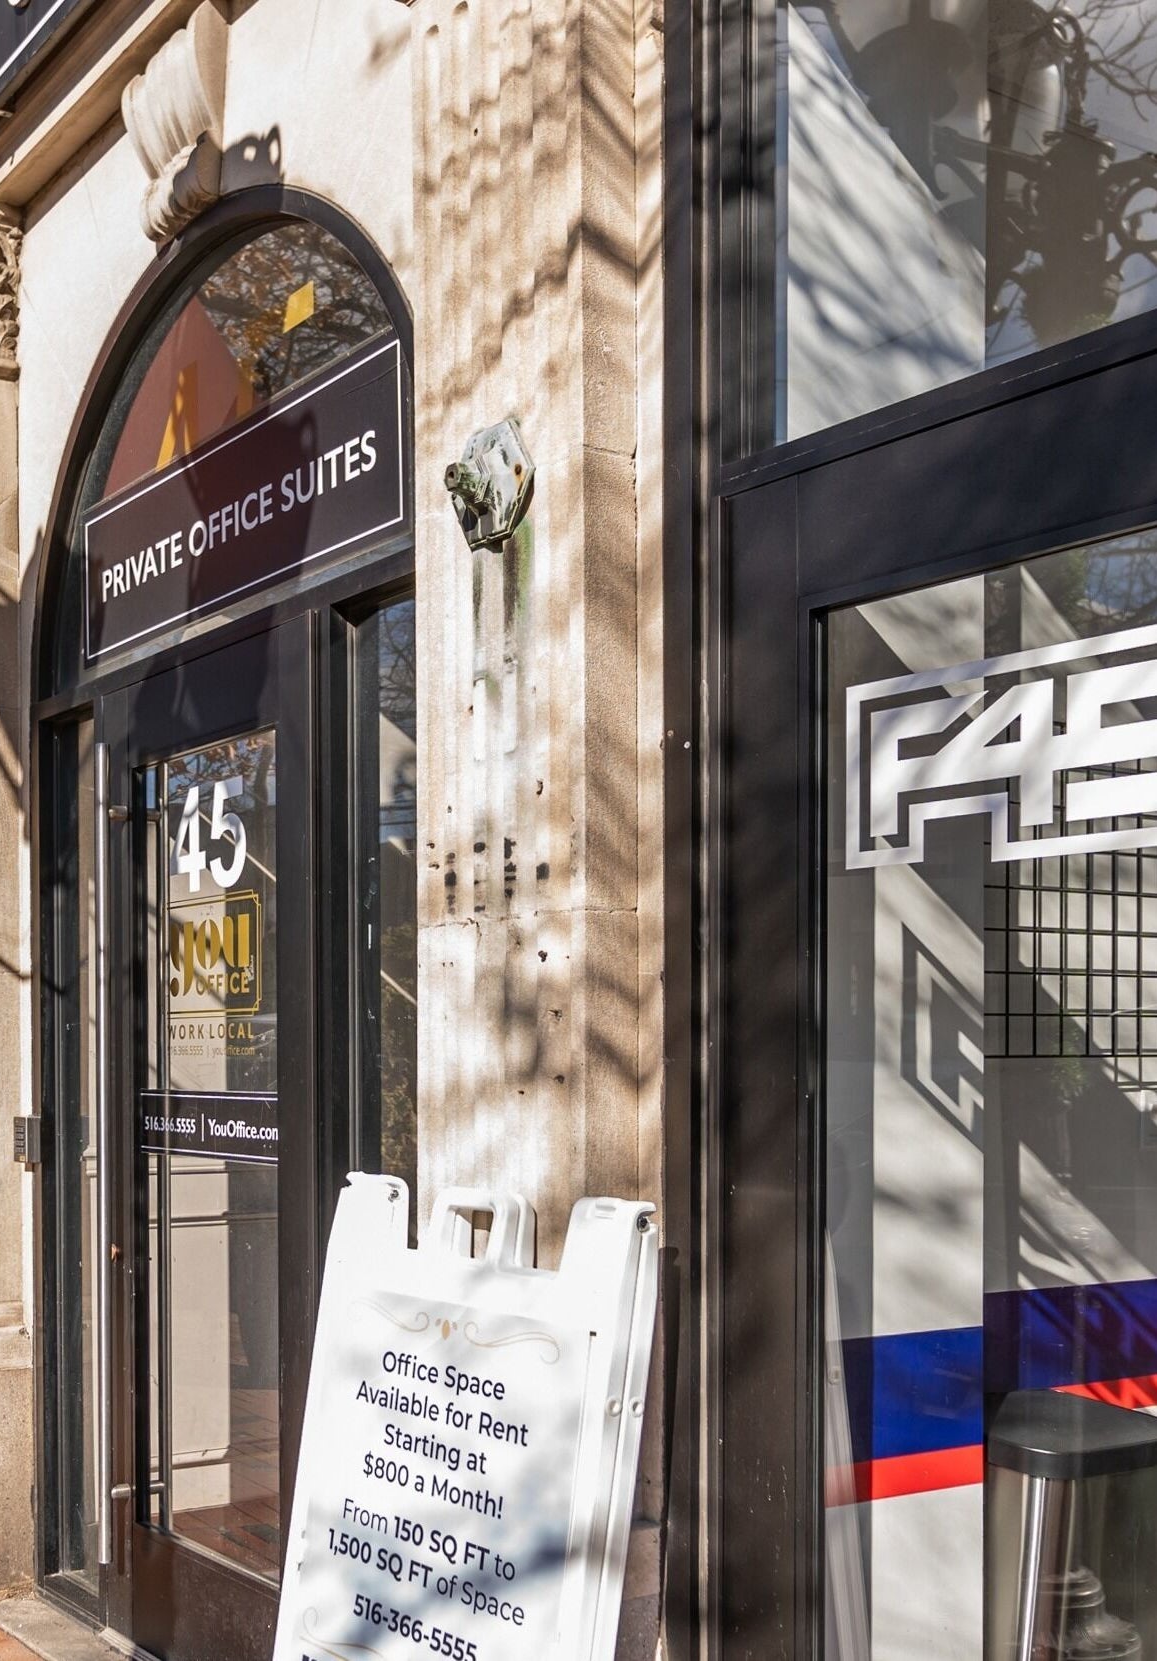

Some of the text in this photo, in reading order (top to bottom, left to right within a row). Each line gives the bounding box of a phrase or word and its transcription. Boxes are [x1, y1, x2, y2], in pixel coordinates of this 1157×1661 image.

[100, 430, 378, 604] PRIVATE OFFICE SUITES
[170, 775, 248, 893] 45
[170, 913, 251, 997] you
[195, 971, 251, 997] OFFICE
[169, 1022, 255, 1040] WORK LOCAL
[169, 1046, 204, 1056] 16.366.5555
[144, 1115, 196, 1134] 516.366.5555
[382, 1351, 505, 1401] Office Space
[356, 1380, 529, 1447] Available for Rent
[383, 1423, 487, 1475] Starting at
[363, 1450, 504, 1519] $800 a Month!
[343, 1498, 516, 1581] From 150 SQ FT to
[328, 1528, 525, 1626] 1,500 SQ FT of Space
[353, 1594, 477, 1661] 516-366-5555
